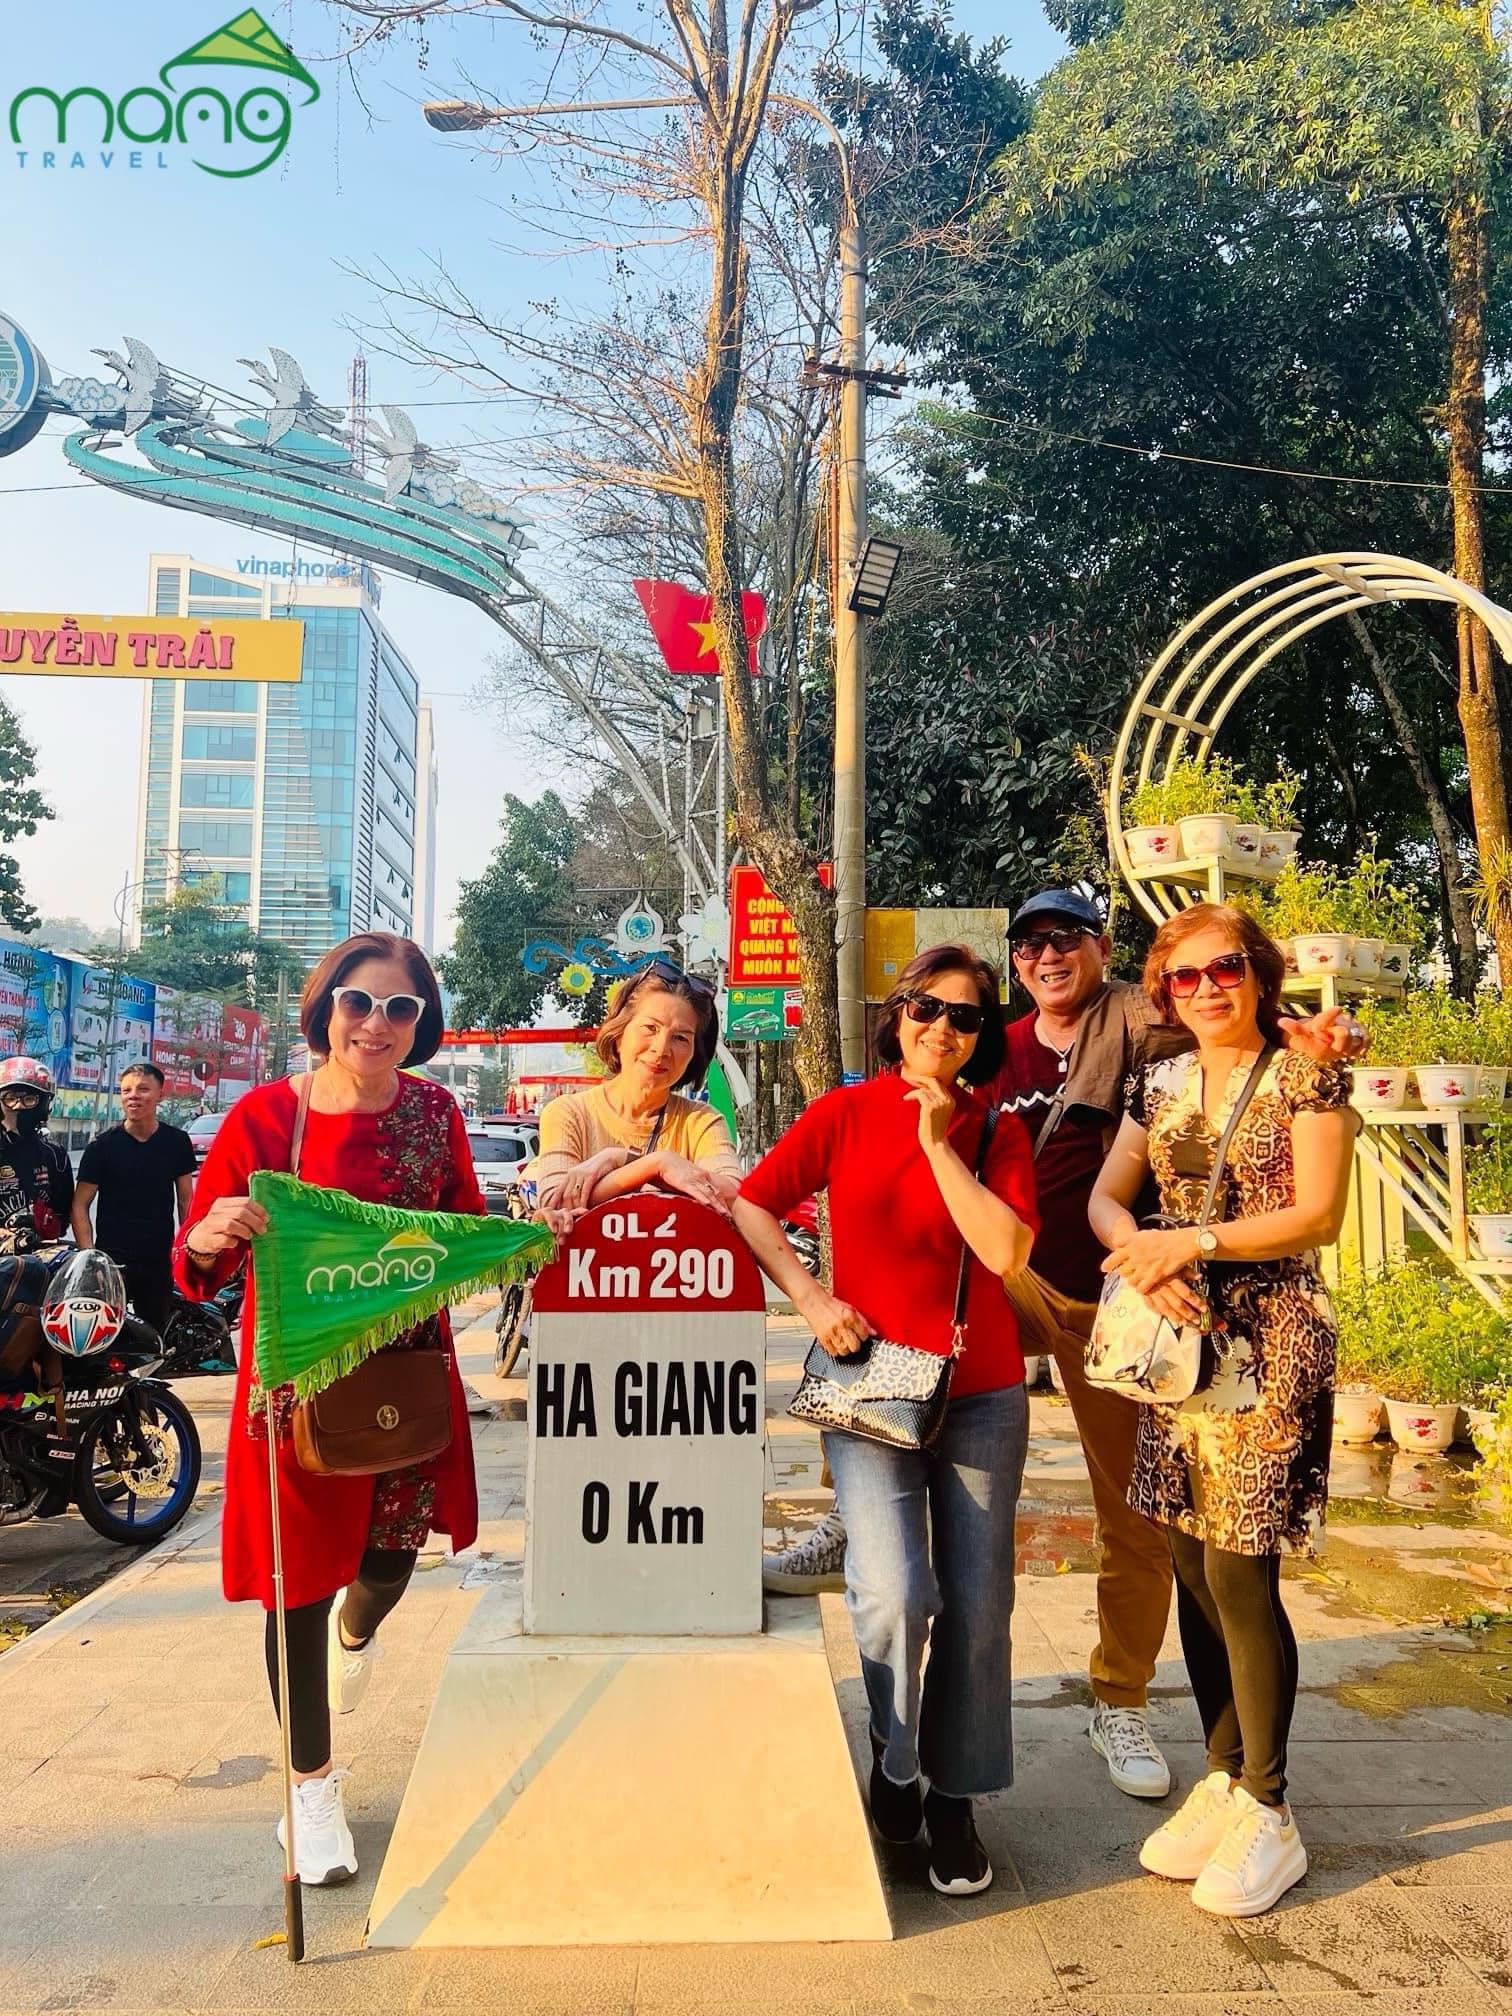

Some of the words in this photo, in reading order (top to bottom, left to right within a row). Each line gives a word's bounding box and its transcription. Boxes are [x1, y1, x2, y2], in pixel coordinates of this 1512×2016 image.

[128, 628, 234, 669] TRÃI
[740, 939, 784, 956] QUANG
[742, 958, 782, 975] MUÔN
[602, 1213, 648, 1241] QL
[654, 1212, 677, 1238] 2
[306, 1255, 435, 1292] mang
[568, 1248, 641, 1298] Km
[650, 1248, 734, 1298] 290
[65, 1390, 89, 1402] HA
[536, 1362, 597, 1437] HA
[614, 1360, 757, 1437] GIANG
[582, 1481, 610, 1544] 0
[627, 1481, 704, 1544] Km
